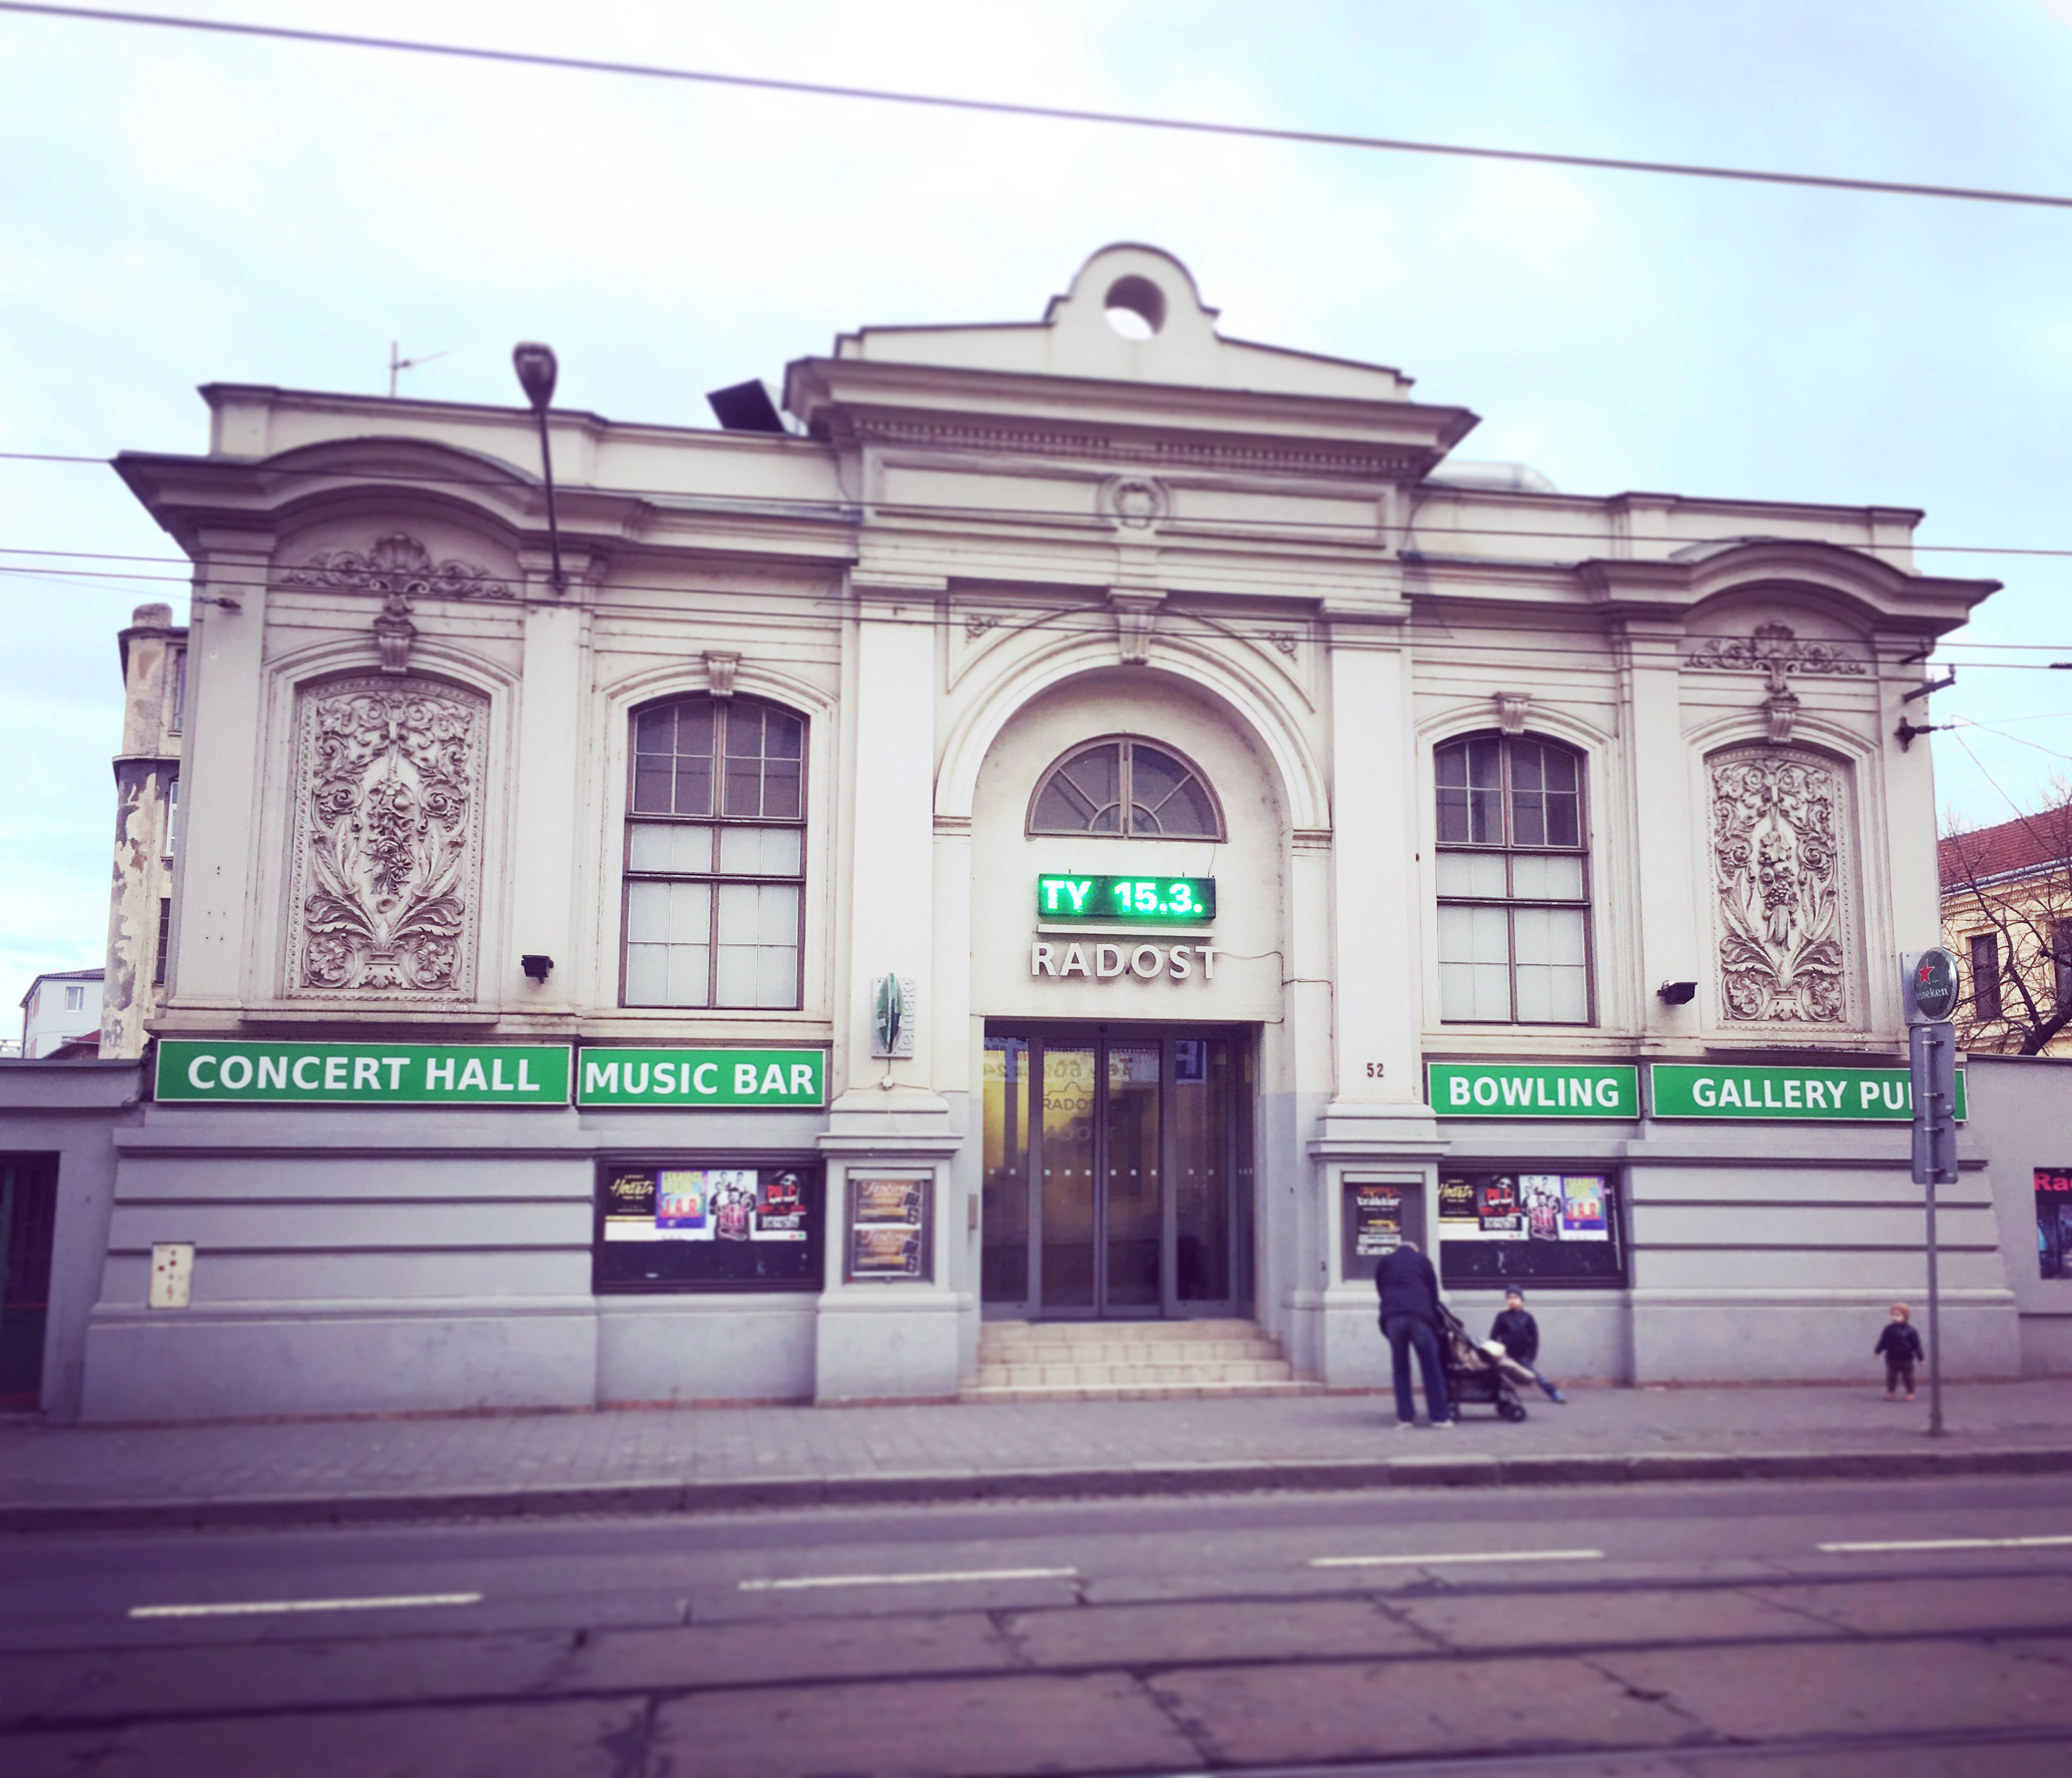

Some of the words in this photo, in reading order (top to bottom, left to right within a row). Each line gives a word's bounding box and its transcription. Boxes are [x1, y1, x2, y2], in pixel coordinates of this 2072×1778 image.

[1042, 880, 1092, 912] TY
[1114, 882, 1203, 914] 15.3.
[1031, 942, 1221, 980] RADOST
[188, 1055, 410, 1089] CONCERT
[426, 1058, 540, 1091] HALL
[585, 1062, 718, 1095] MUSIC
[734, 1064, 815, 1095] BAR
[1367, 1062, 1384, 1078] 52
[1450, 1077, 1619, 1107] BOWLING
[1692, 1078, 1847, 1109] GALLERY
[1860, 1081, 1913, 1110] PU
[2034, 1173, 2072, 1192] Ra
